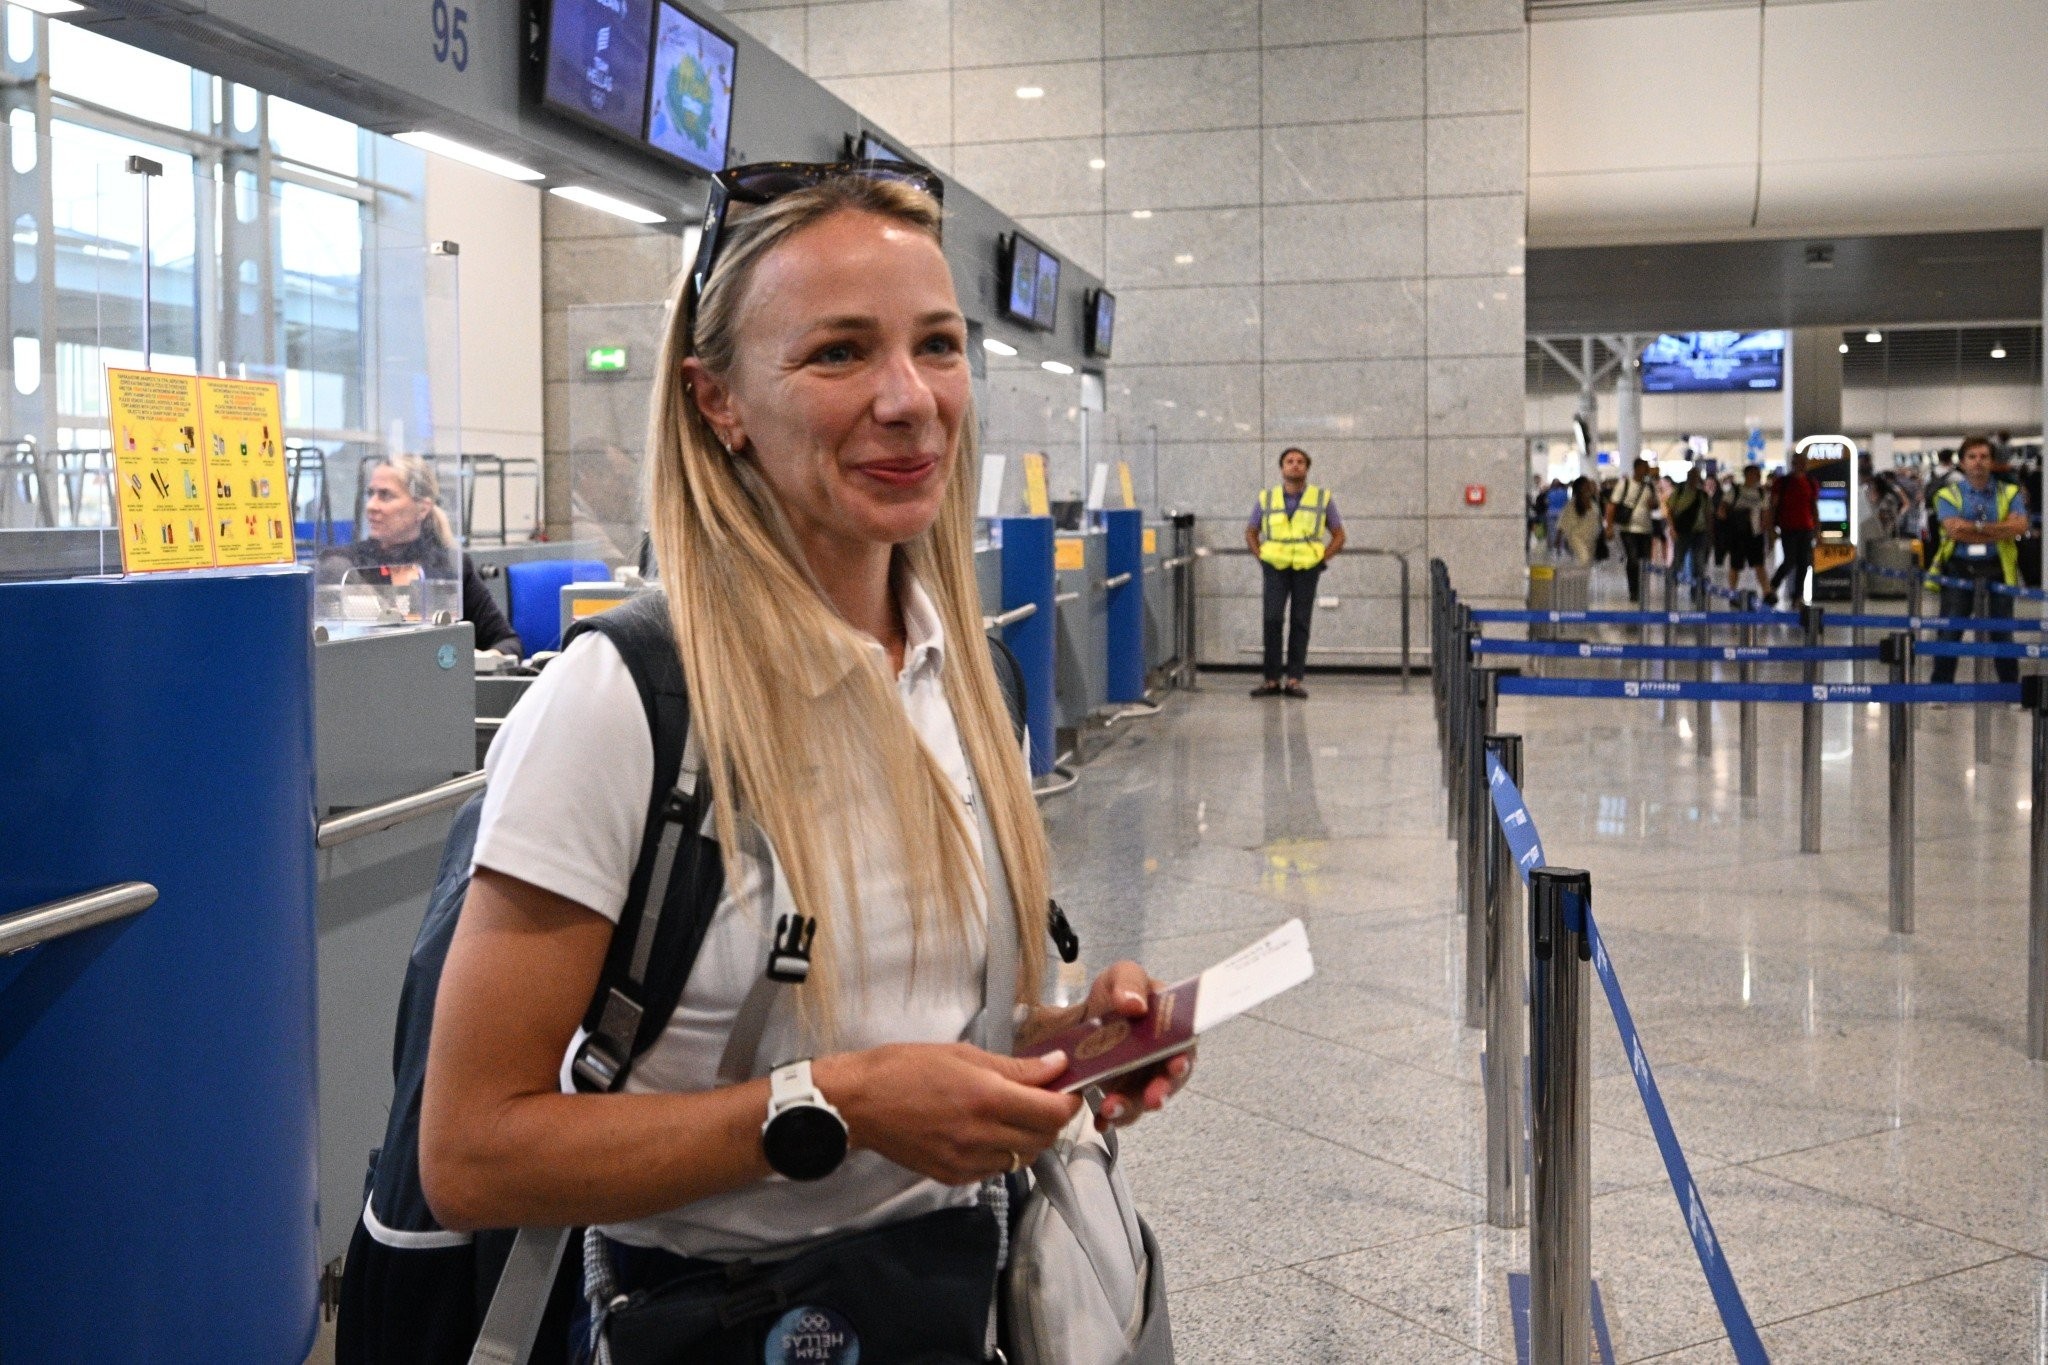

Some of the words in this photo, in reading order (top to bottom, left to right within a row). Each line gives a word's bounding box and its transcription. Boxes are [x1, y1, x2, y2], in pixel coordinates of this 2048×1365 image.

[432, 0, 468, 72] 95
[1807, 443, 1844, 460] ATM
[1640, 683, 1681, 692] ATHENS
[1829, 685, 1872, 695] ATHENS
[782, 1331, 844, 1349] HELLAS
[796, 1348, 829, 1359] TEAM
